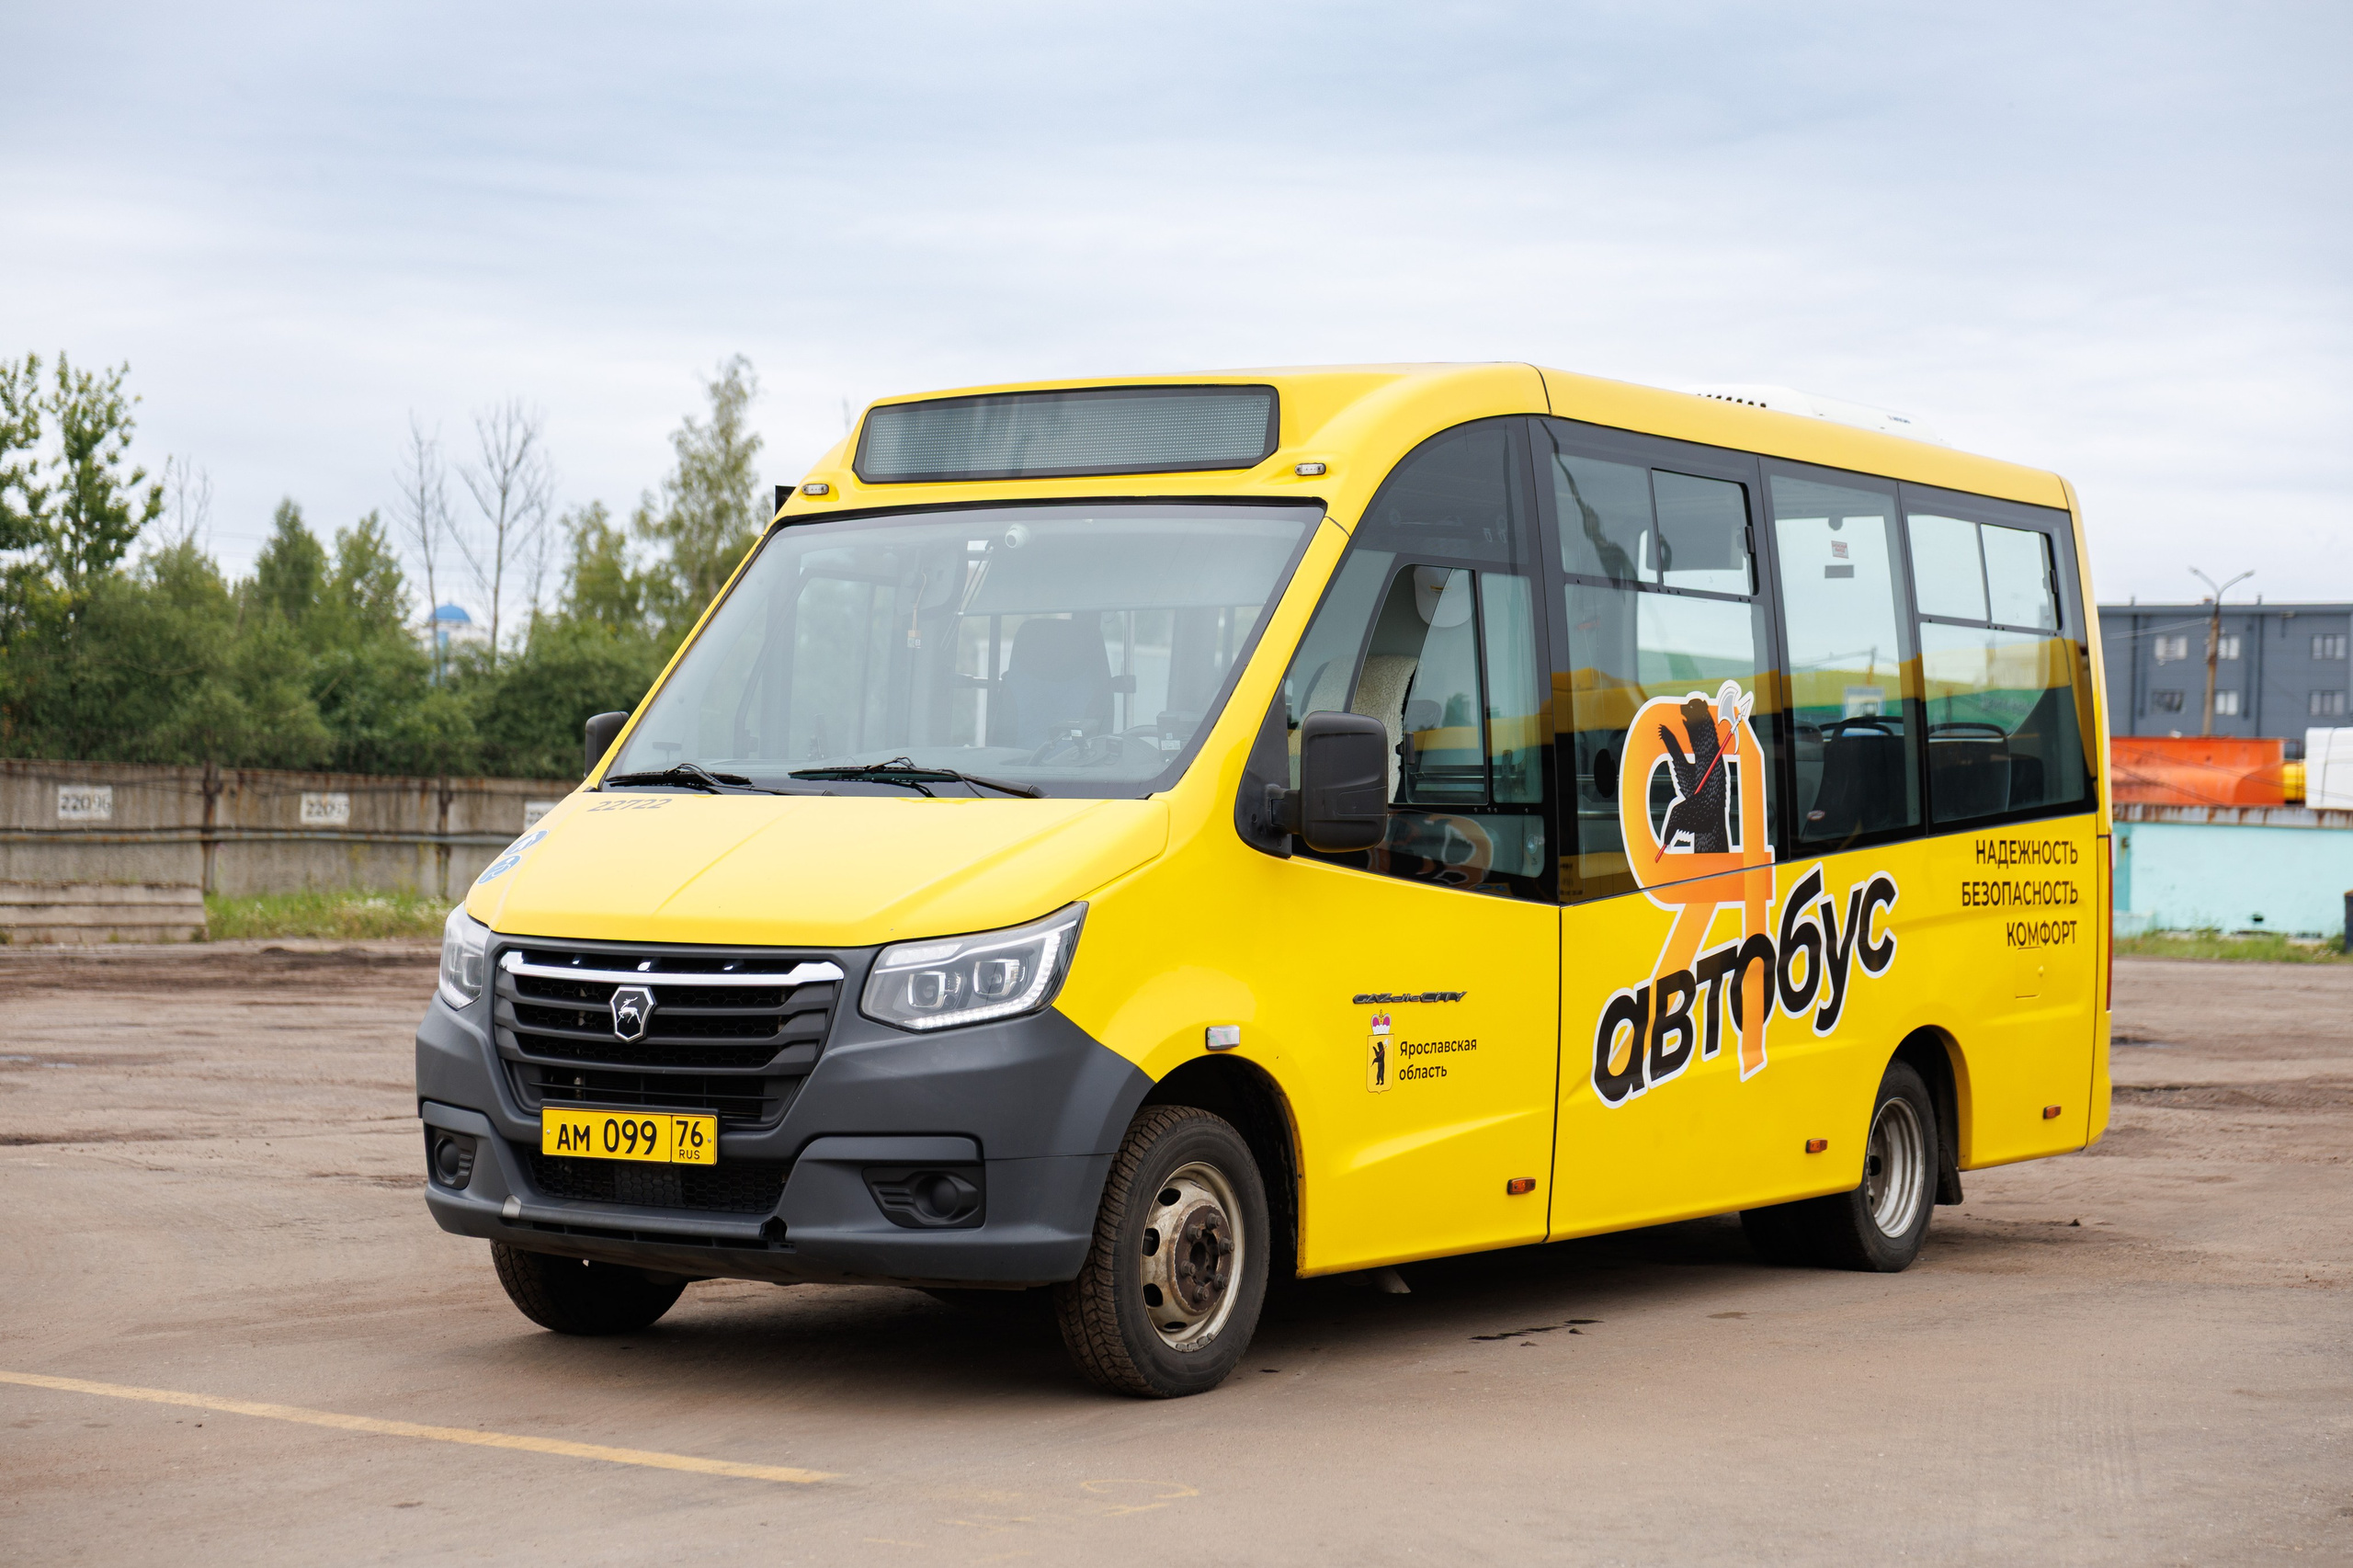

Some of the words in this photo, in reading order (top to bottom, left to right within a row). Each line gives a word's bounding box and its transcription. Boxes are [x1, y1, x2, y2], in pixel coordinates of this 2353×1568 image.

[586, 798, 673, 812] 22722
[1975, 839, 2078, 869] НАДЕЖНОСТЬ
[1961, 881, 2078, 906] БЕЗОПАСНОСТЬ
[2006, 920, 2077, 947] КОМФОРТ
[1593, 866, 1897, 1103] автобус
[1400, 1040, 1477, 1059] Ярославская
[1399, 1064, 1447, 1081] область
[603, 1119, 657, 1155] 099
[676, 1120, 704, 1148] 76
[678, 1150, 700, 1160] RUS
